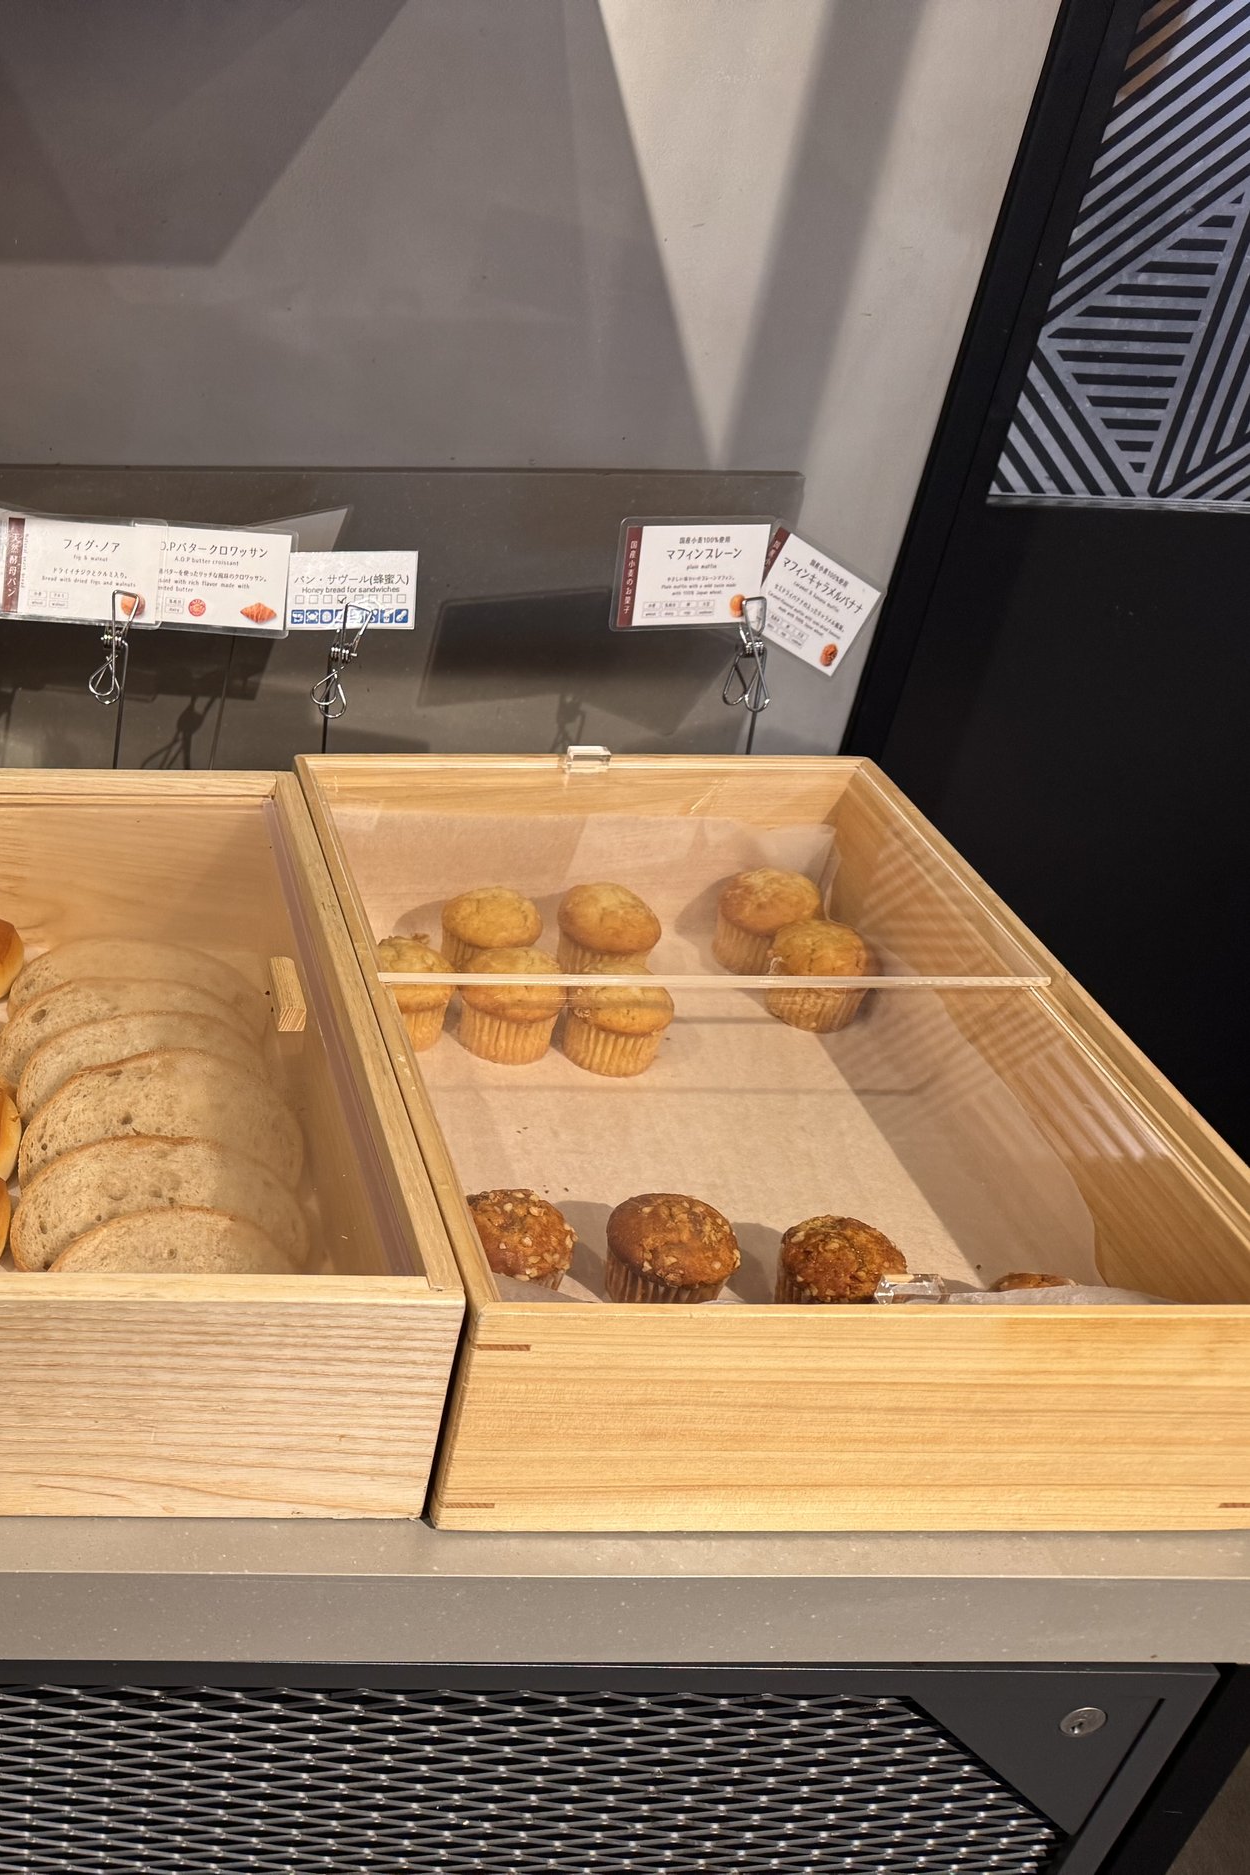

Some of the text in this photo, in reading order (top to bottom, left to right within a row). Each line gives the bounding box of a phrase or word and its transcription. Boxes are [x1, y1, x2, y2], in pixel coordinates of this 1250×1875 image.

[666, 548, 743, 561] マフィンプレーン
[212, 558, 239, 566] croissant
[302, 586, 324, 594] Honey
